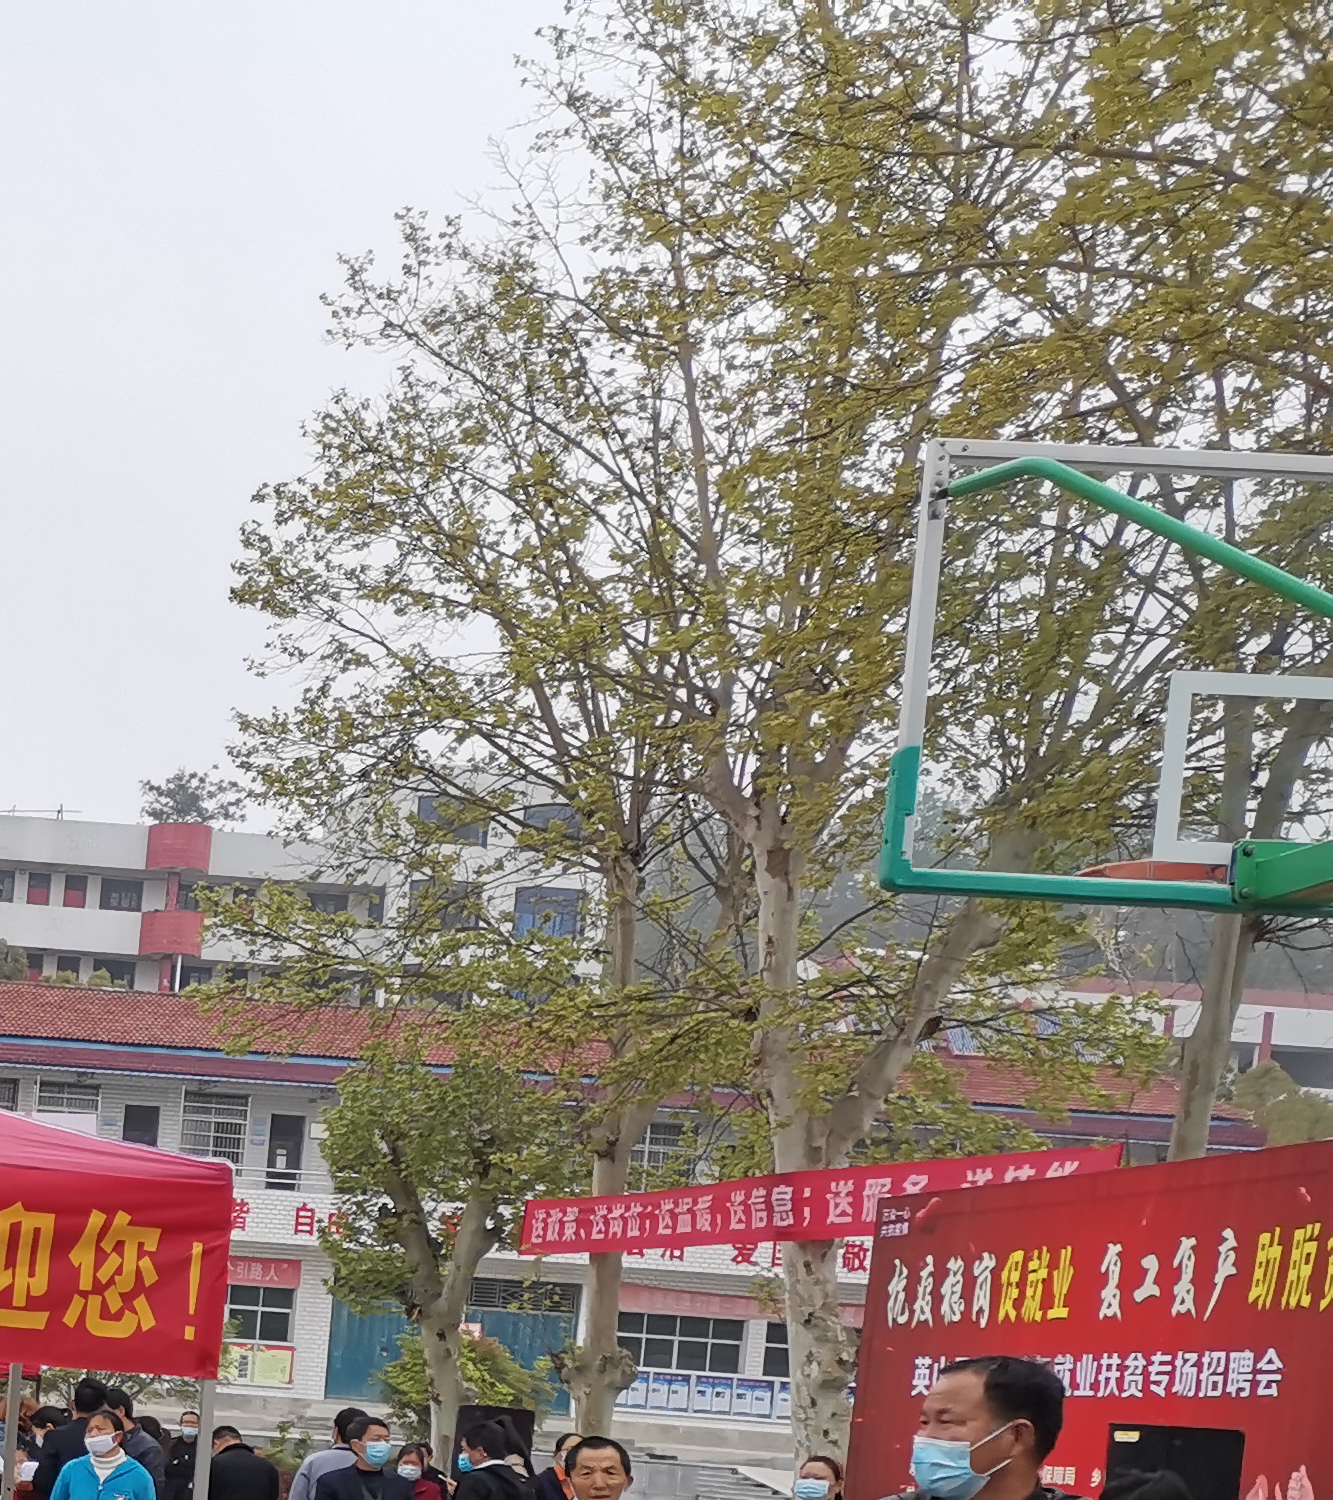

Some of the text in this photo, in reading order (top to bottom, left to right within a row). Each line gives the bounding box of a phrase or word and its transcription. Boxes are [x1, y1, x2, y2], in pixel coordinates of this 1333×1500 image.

[887, 1246, 1074, 1329] 抗疫稳岗促就业
[1099, 1228, 1238, 1322] 复工复产
